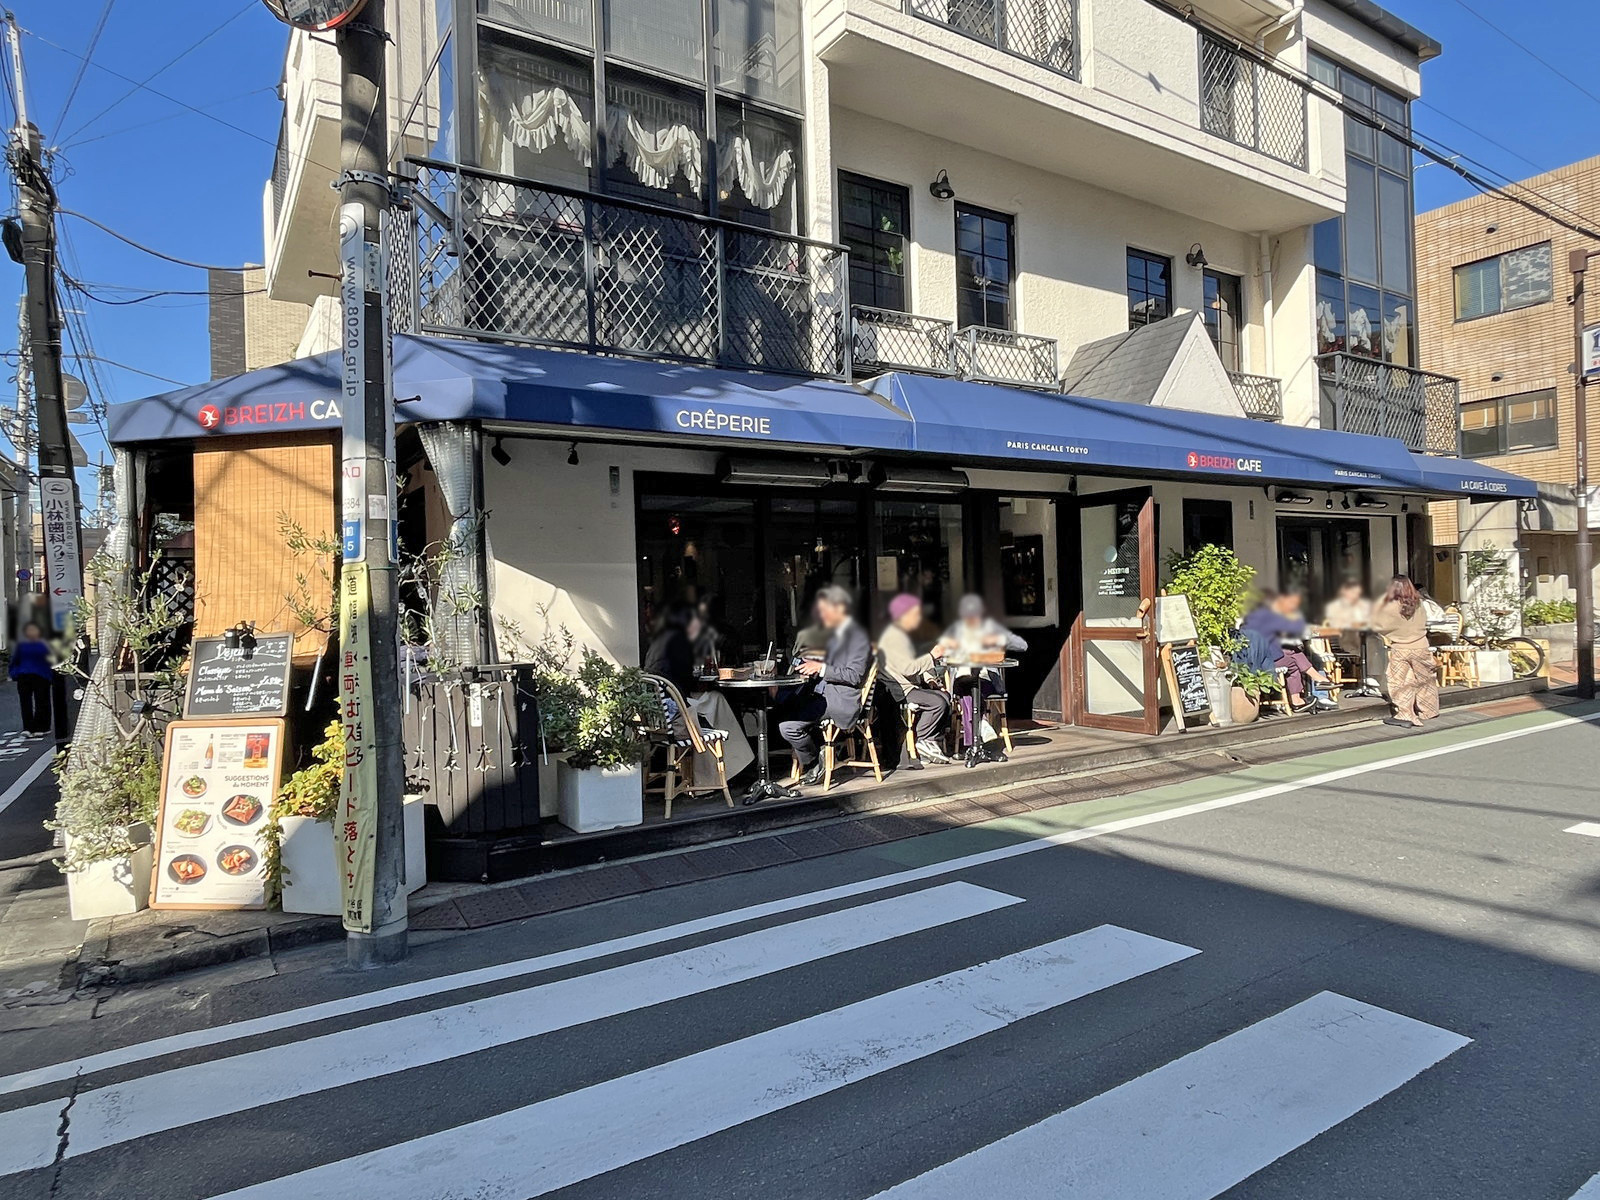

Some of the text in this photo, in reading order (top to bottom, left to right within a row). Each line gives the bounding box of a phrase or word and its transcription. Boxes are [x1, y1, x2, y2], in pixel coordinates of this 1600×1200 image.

[346, 256, 360, 398] www.8020.gr.jp
[224, 399, 342, 426] BREIZH CA
[676, 408, 771, 434] CRÊPERIE
[1007, 441, 1089, 455] PARIS CANCALE TOKYO
[1200, 455, 1262, 473] BREIZH CAFE
[1461, 480, 1469, 490] LA
